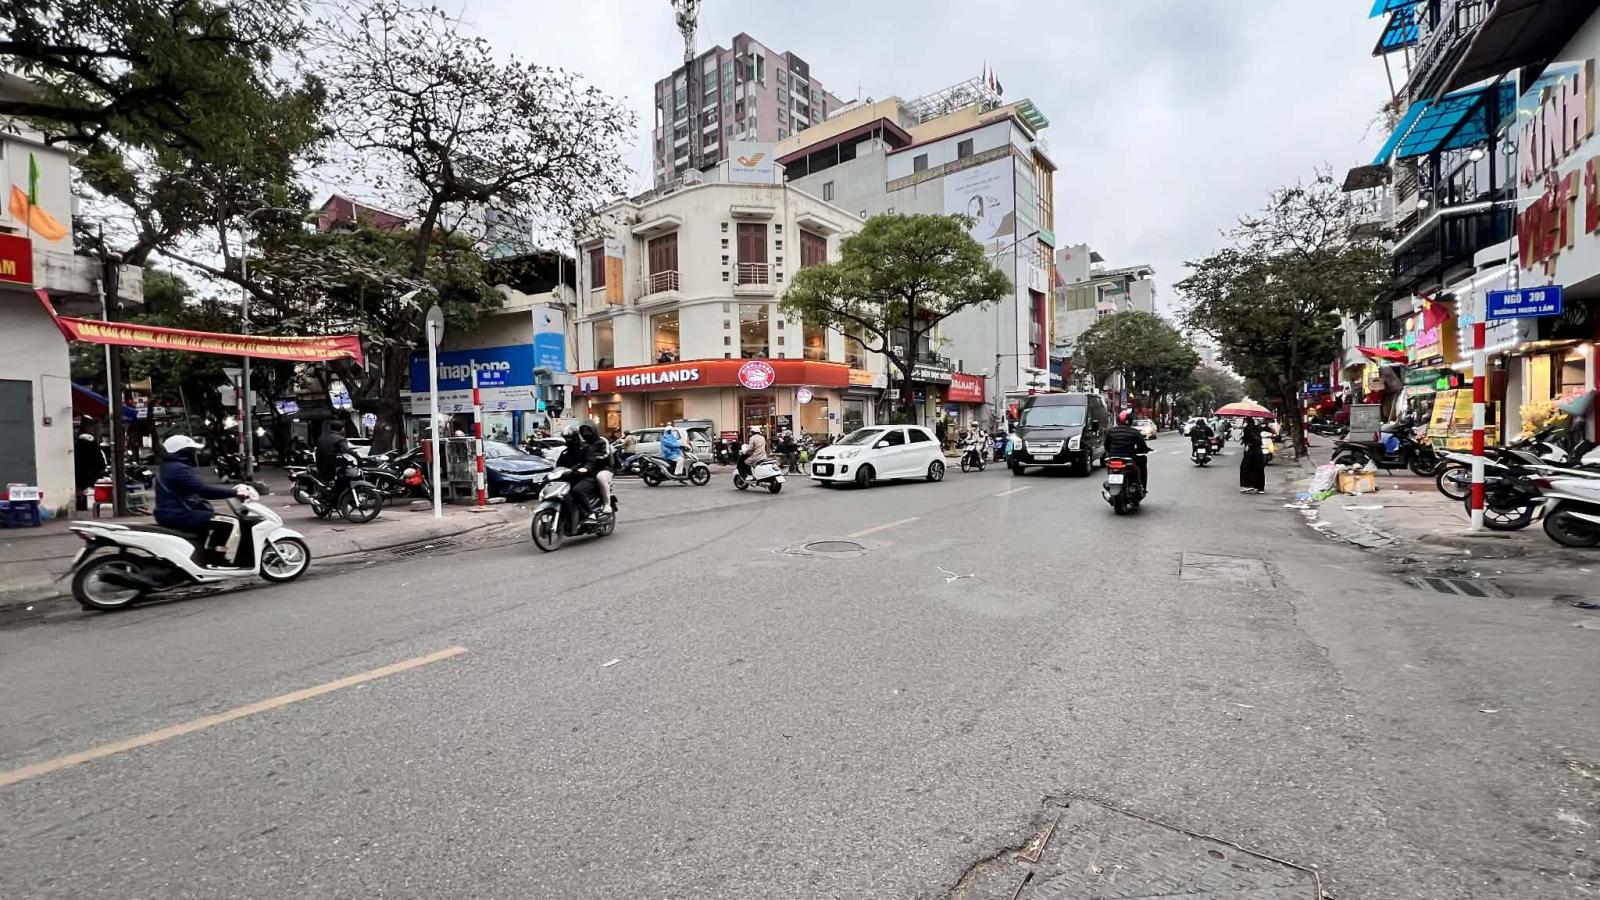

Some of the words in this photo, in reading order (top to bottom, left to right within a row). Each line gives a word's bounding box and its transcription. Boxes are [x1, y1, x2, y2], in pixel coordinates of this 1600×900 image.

[1518, 62, 1591, 187] KÍNH
[1517, 169, 1580, 277] VIỆT
[1528, 291, 1545, 303] 399
[437, 359, 511, 381] inaphone
[616, 368, 699, 387] HIGHLANDS
[745, 380, 769, 388] COFFEE
